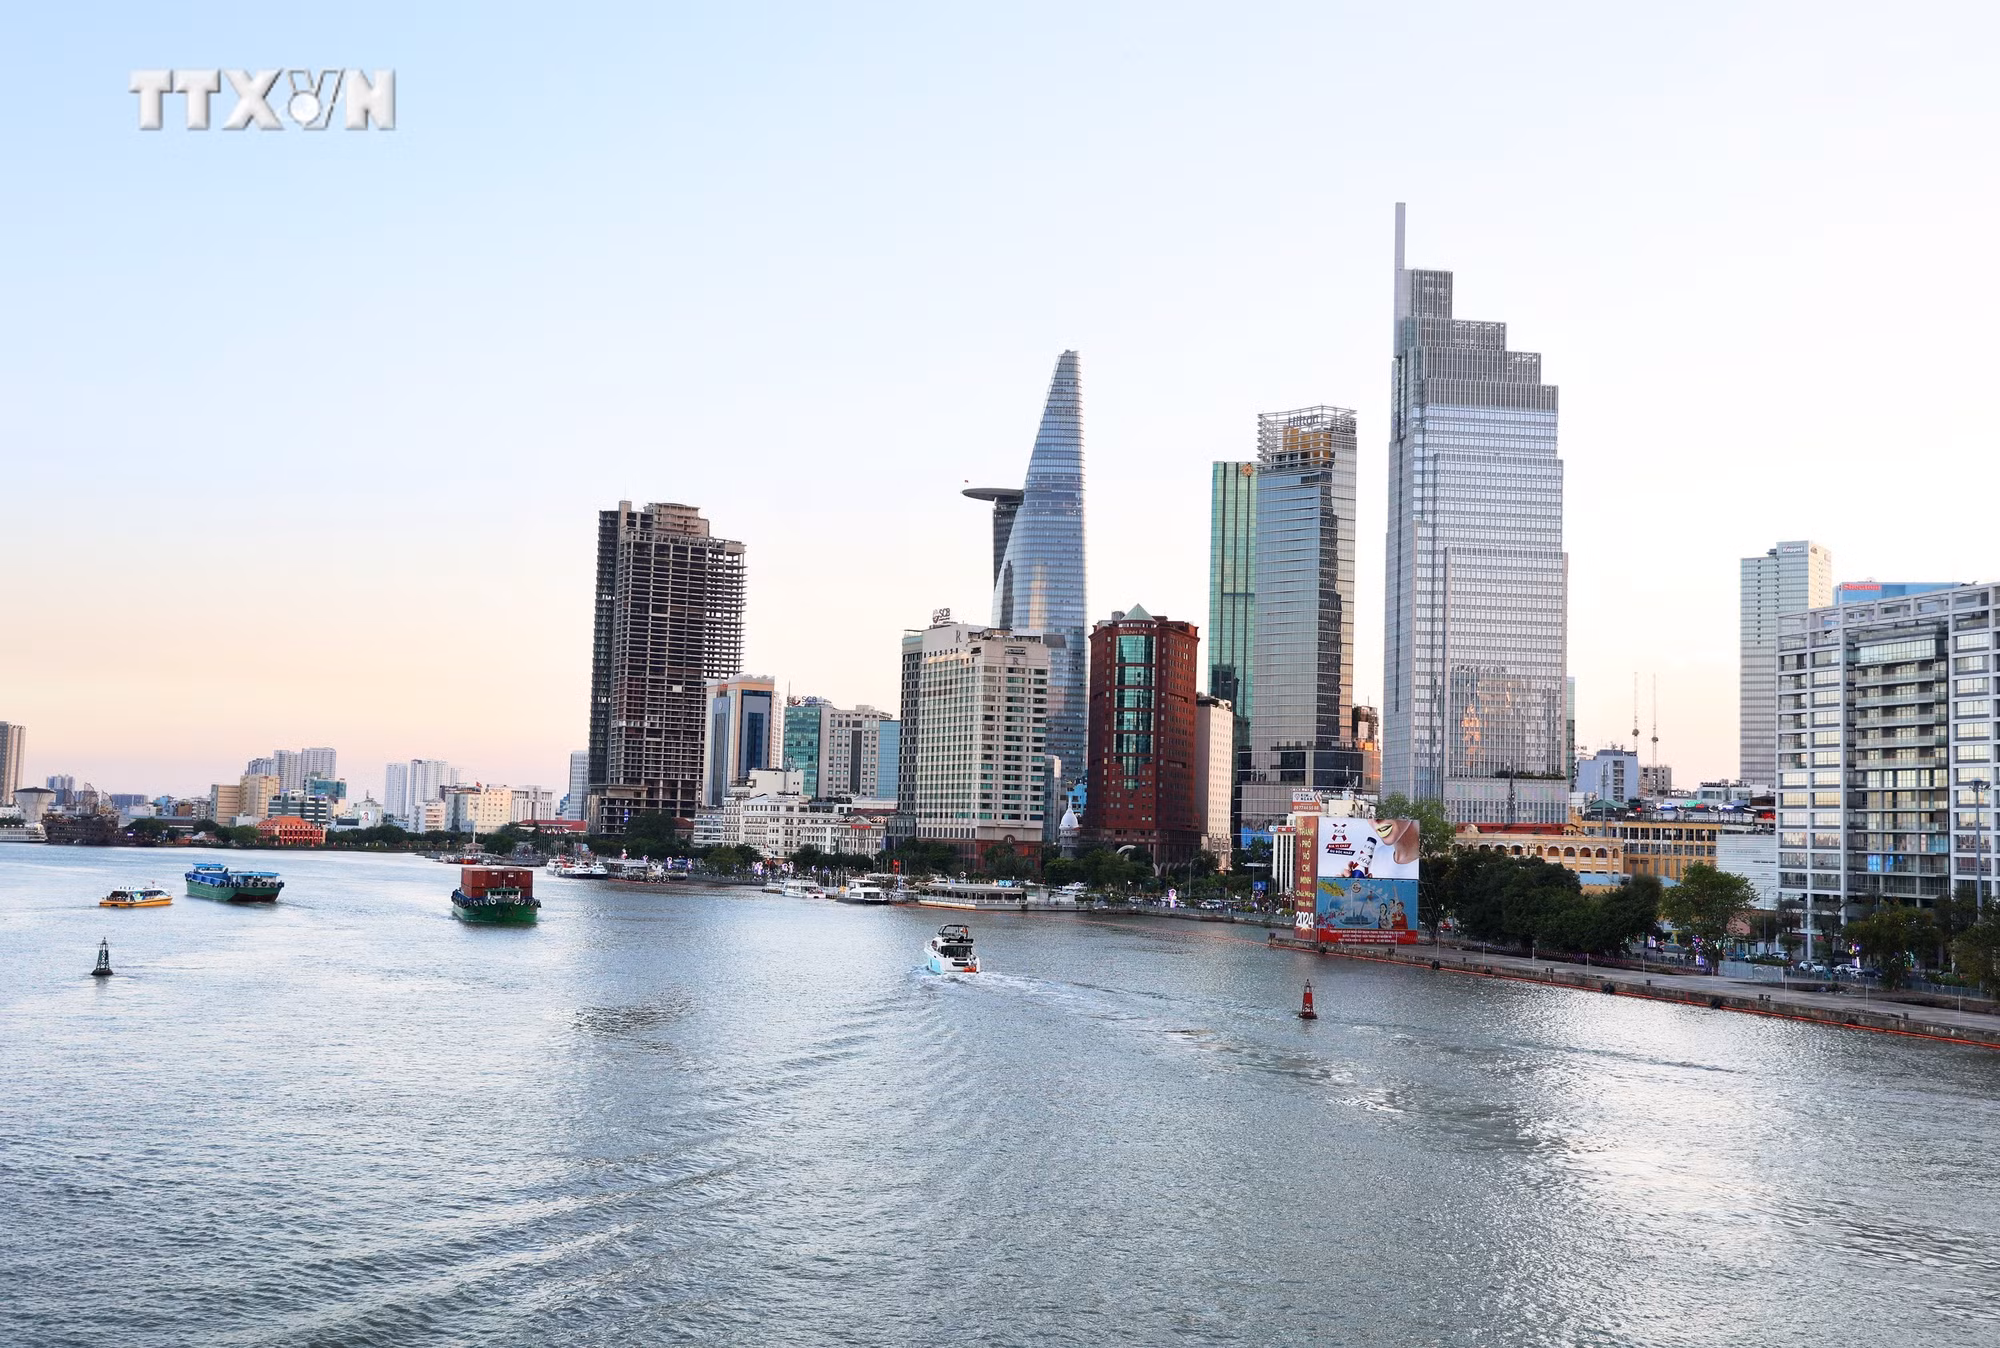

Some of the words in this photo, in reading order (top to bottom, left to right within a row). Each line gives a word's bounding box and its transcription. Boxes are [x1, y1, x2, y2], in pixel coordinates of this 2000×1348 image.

[1288, 414, 1319, 426] Hilton
[1782, 545, 1803, 553] Keppel
[955, 629, 962, 643] R
[1012, 657, 1019, 665] R
[1296, 911, 1314, 928] 2024
